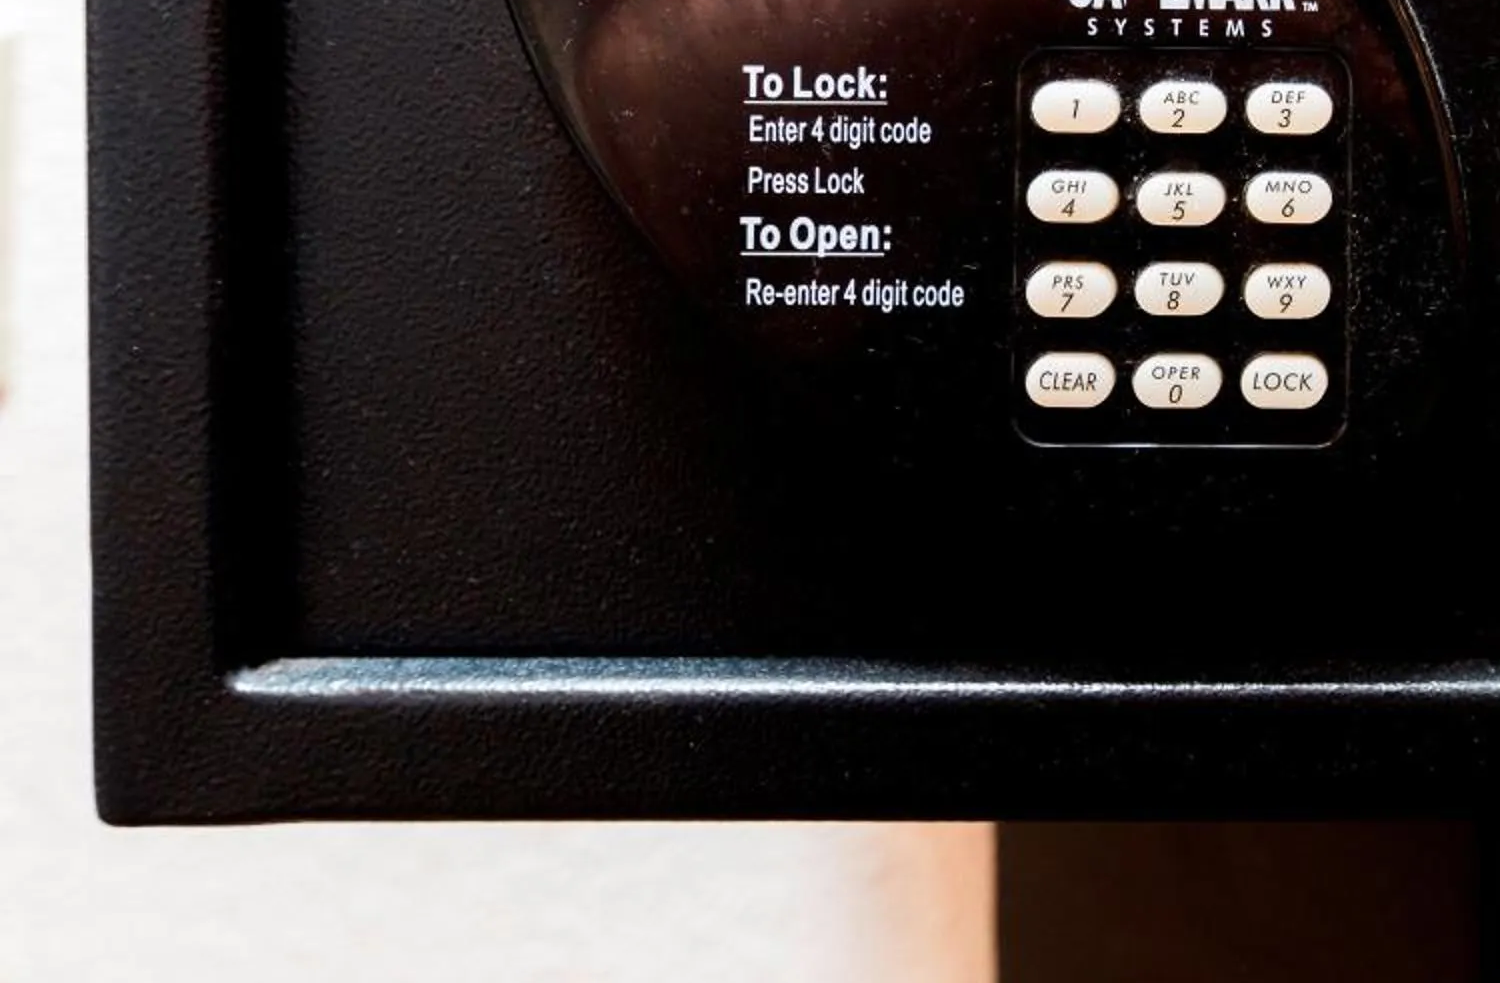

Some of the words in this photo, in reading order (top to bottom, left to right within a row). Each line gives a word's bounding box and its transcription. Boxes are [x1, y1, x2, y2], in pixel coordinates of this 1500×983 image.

[1086, 17, 1273, 38] SYSTEMS
[742, 64, 785, 100] To
[792, 64, 888, 101] Lock:
[1162, 90, 1201, 106] ABC
[1270, 90, 1307, 105] DEF
[1070, 98, 1081, 120] 1
[1171, 108, 1187, 129] 2
[1277, 108, 1293, 129] 3
[748, 114, 808, 143] Enter
[811, 114, 825, 143] 4
[829, 114, 877, 150] digit
[879, 116, 933, 144] code
[747, 166, 810, 195] Press
[814, 166, 866, 195] Lock
[1050, 179, 1088, 195] GHI
[1163, 182, 1195, 198] JKL
[1263, 179, 1314, 195] MNO
[1060, 198, 1077, 219] 4
[1170, 200, 1188, 221] 5
[1280, 197, 1296, 219] 6
[739, 216, 782, 251] To
[788, 216, 892, 258] Open:
[1051, 273, 1085, 290] PRS
[1158, 271, 1196, 287] TUV
[1266, 273, 1308, 290] WXY
[745, 277, 841, 307] Re-enter
[843, 277, 857, 307] 4
[861, 277, 909, 314] digit
[912, 279, 966, 307] code
[1059, 292, 1076, 314] 7
[1165, 290, 1181, 311] 8
[1278, 292, 1294, 315] 9
[1037, 370, 1098, 393] CLEAR
[1150, 365, 1202, 381] OPER
[1251, 370, 1314, 393] LOCK
[1168, 383, 1184, 405] 0
